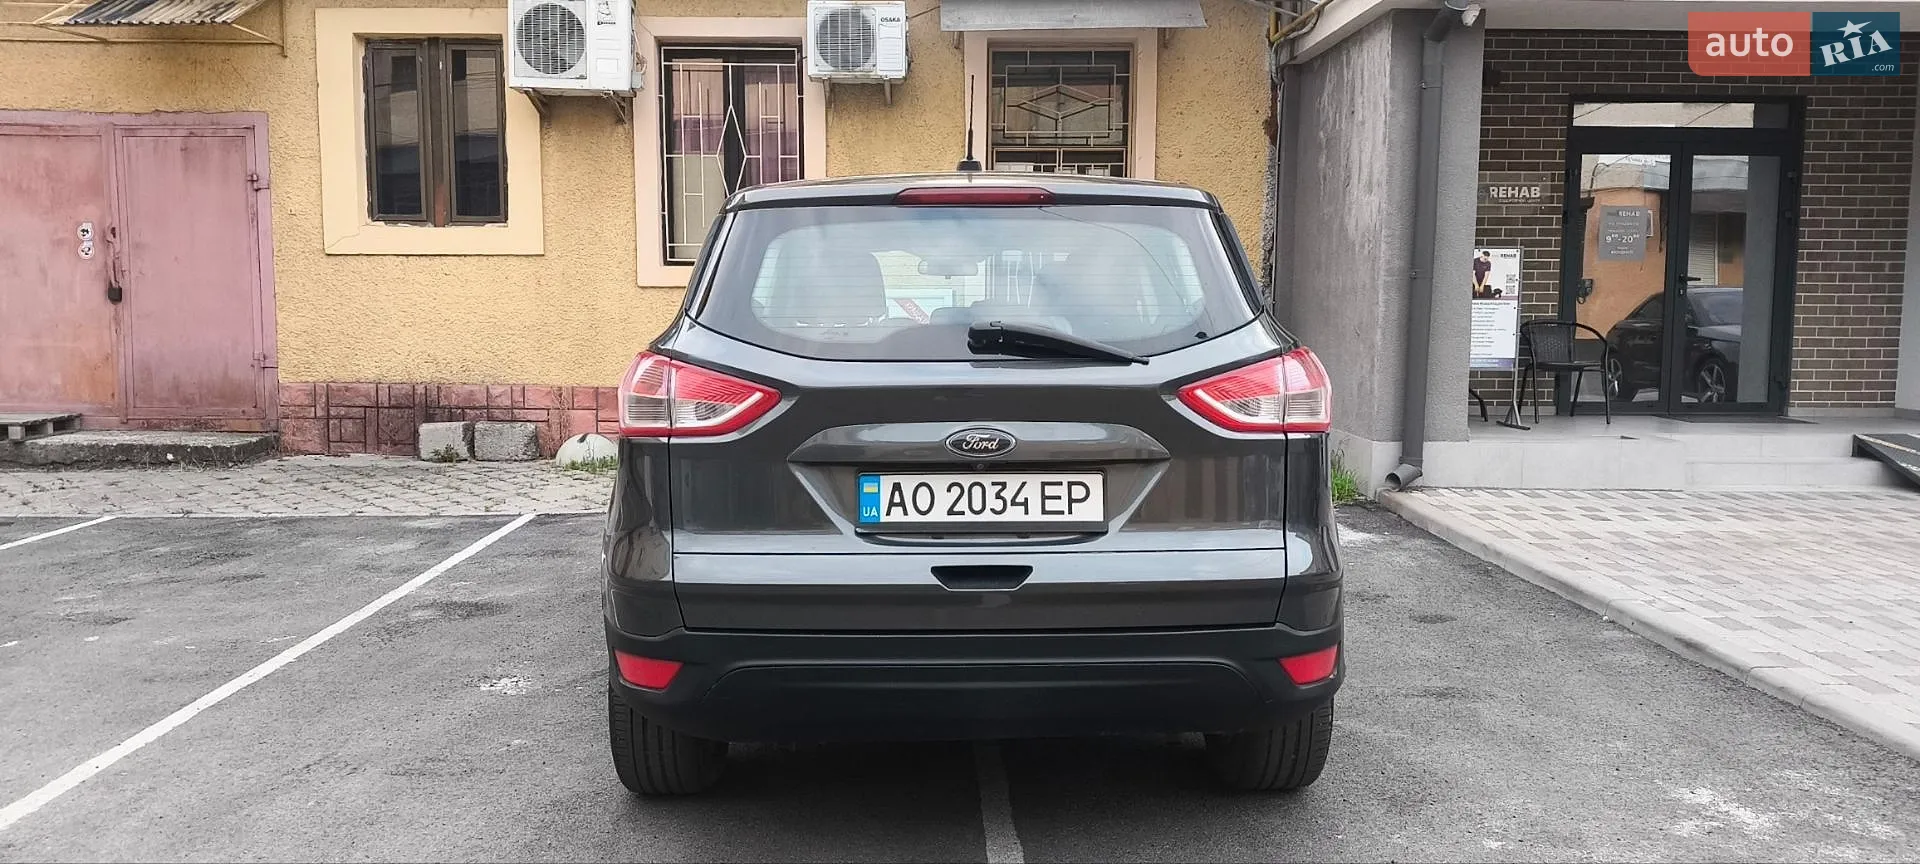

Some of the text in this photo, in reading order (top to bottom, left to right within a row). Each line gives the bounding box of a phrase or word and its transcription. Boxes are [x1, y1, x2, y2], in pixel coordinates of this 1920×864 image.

[1489, 186, 1541, 198] REHAB
[962, 433, 999, 450] Ford
[885, 481, 1091, 516] AO 2034 EP
[863, 506, 879, 517] UA
